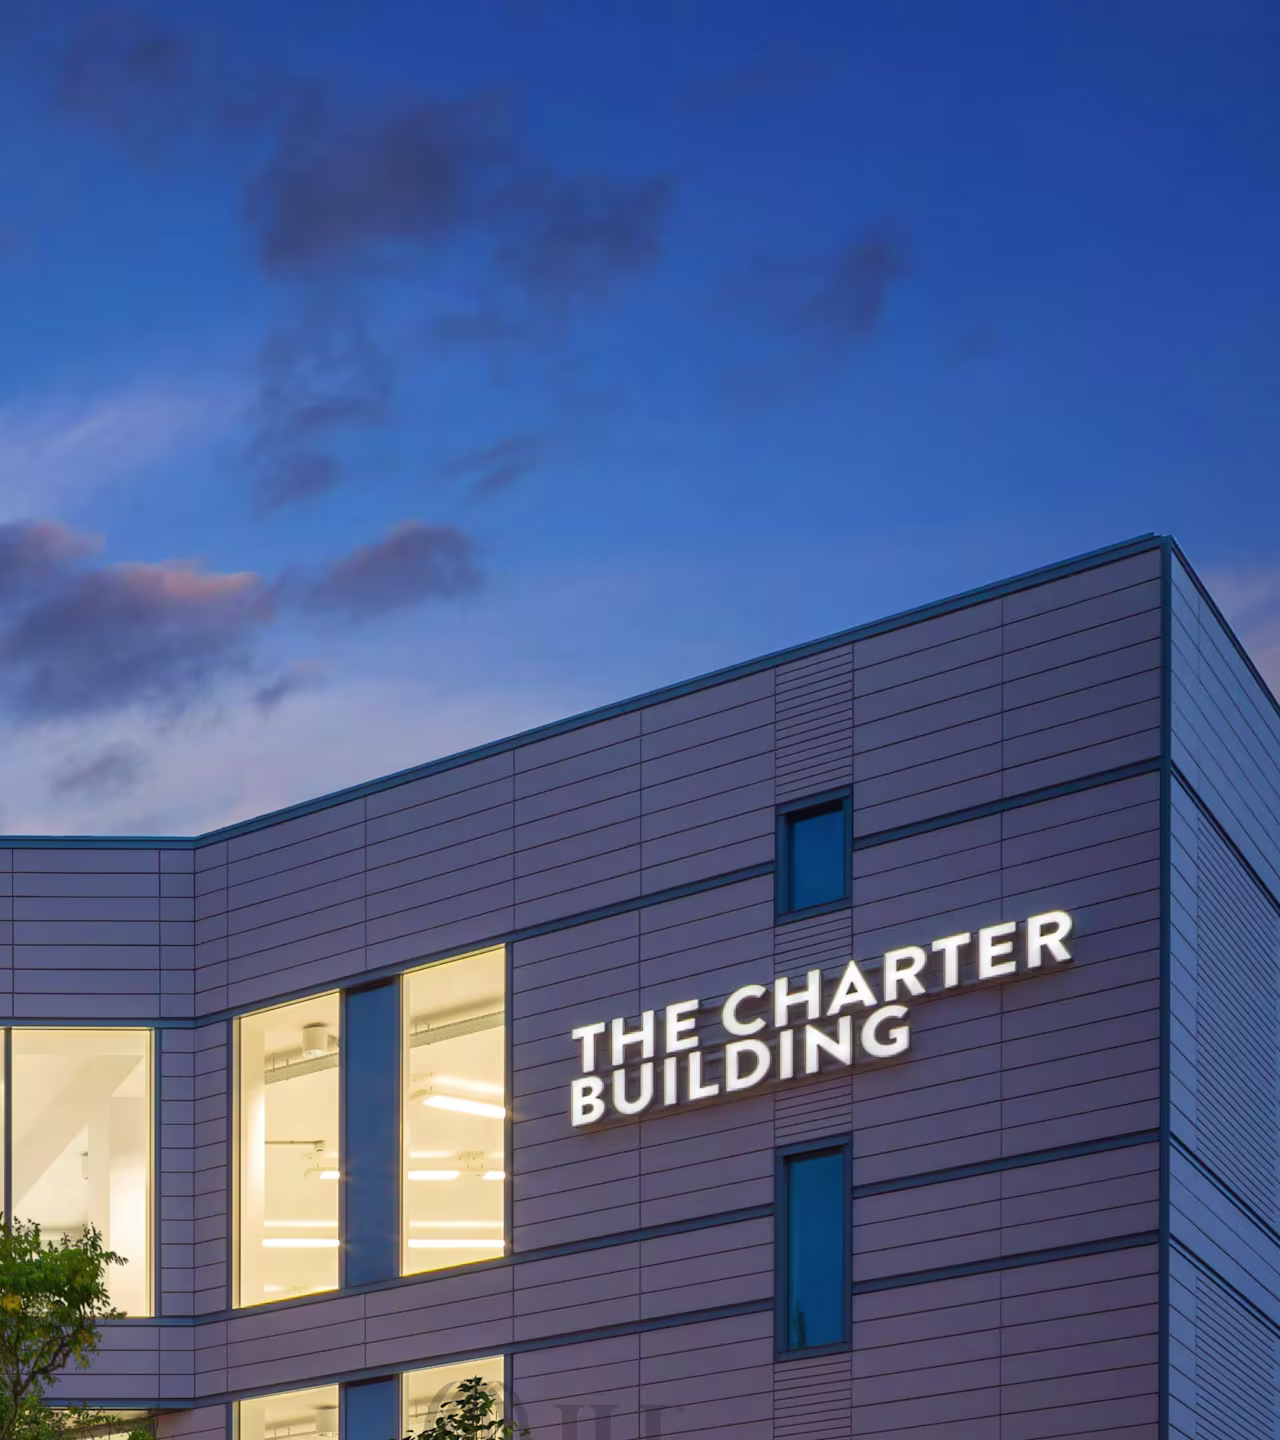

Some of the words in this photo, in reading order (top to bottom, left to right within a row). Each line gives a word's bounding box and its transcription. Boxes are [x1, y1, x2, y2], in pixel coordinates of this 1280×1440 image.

[571, 998, 701, 1073] THE
[721, 909, 1075, 1037] CHARTER
[570, 1004, 912, 1127] BUILDING
